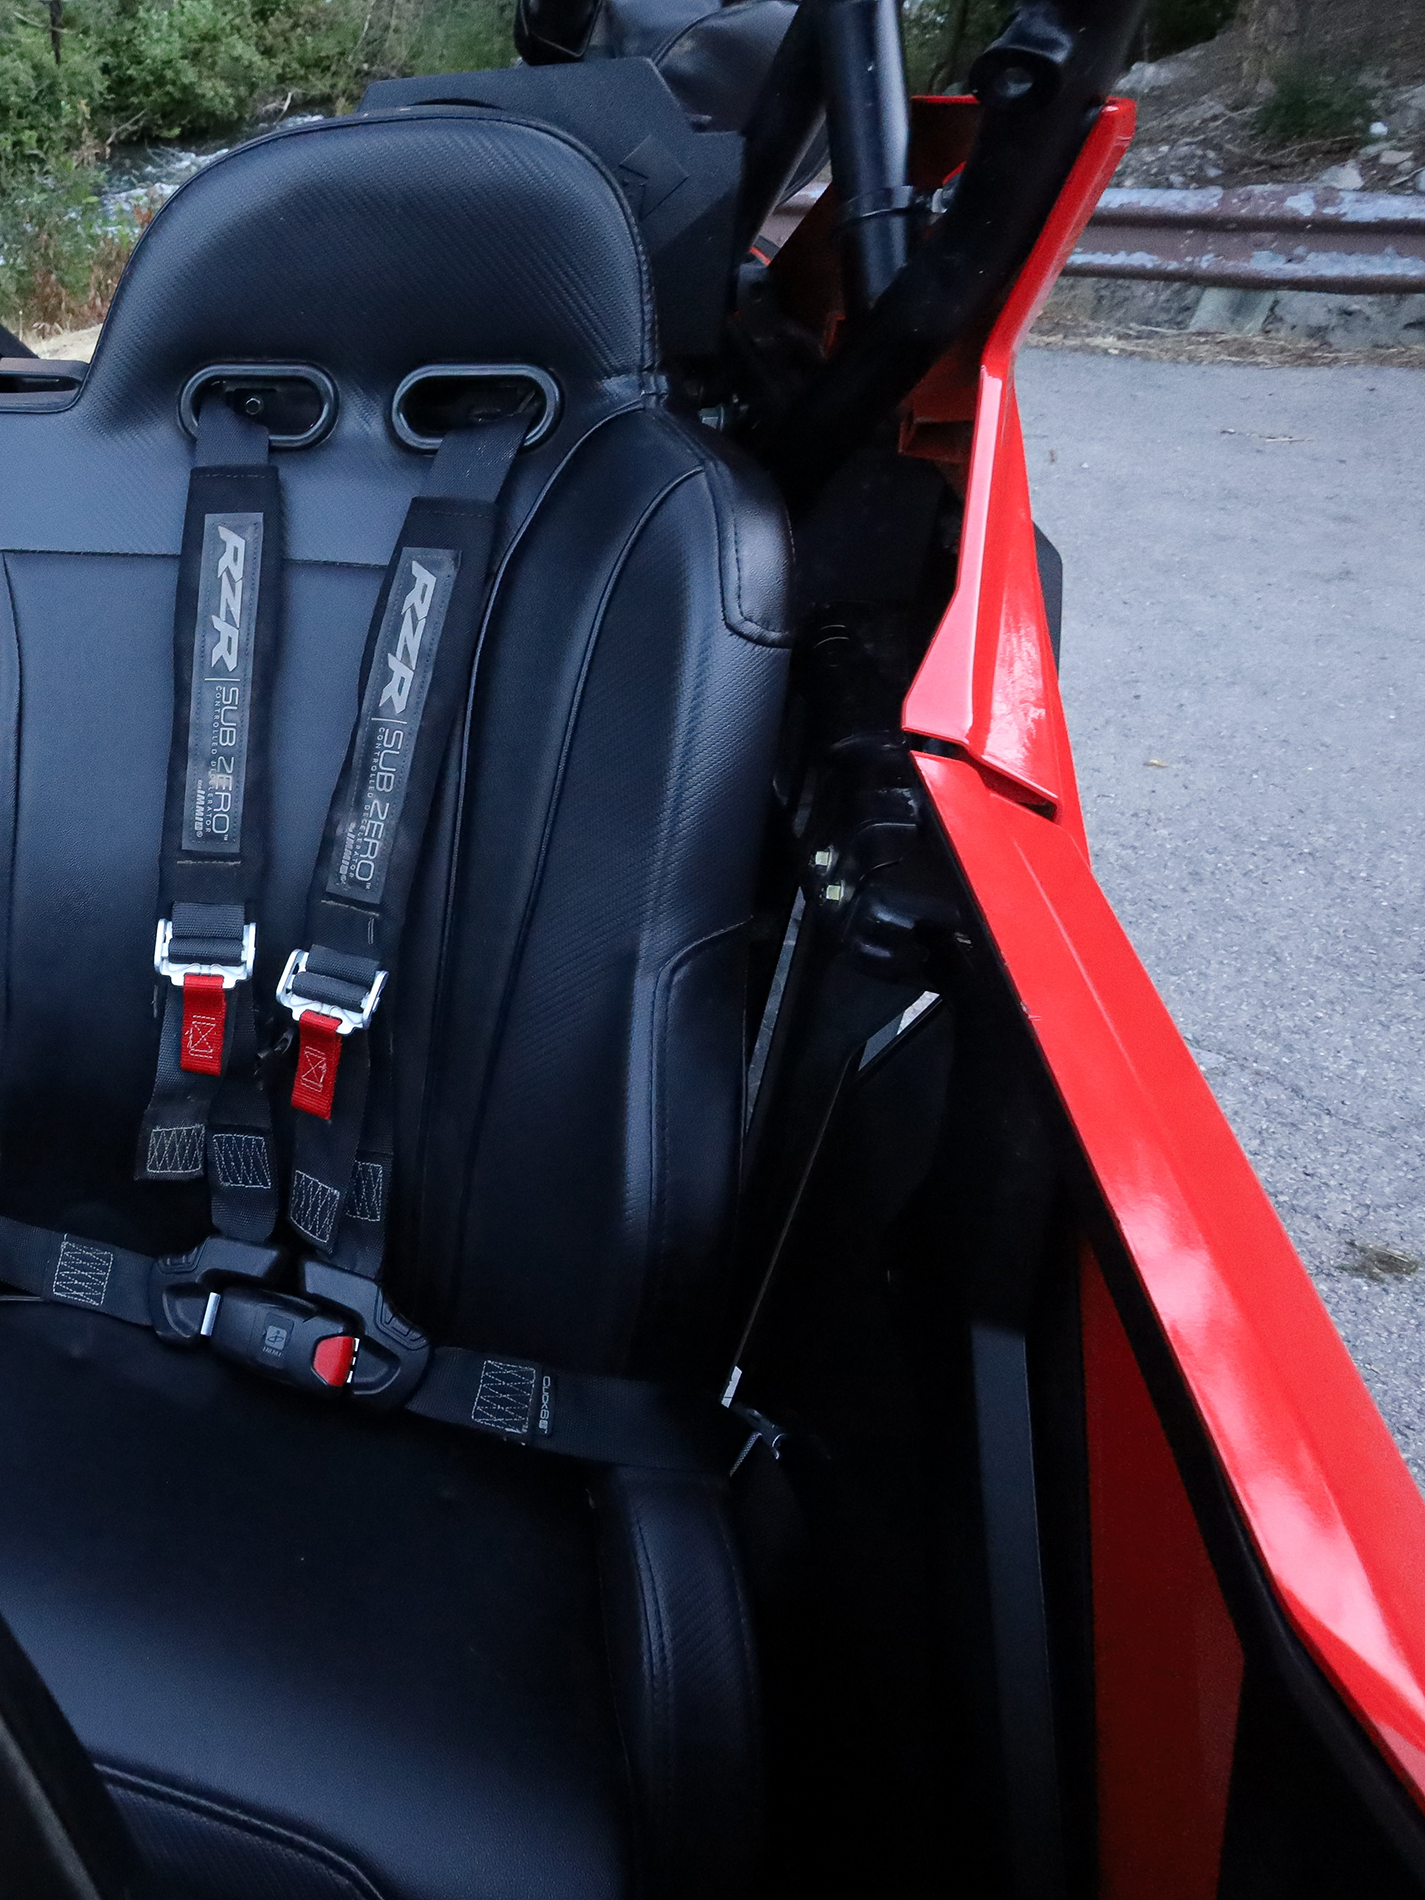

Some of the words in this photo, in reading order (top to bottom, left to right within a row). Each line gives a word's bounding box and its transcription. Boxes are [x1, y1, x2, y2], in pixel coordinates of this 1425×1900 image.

[211, 525, 246, 672] RZR
[379, 560, 436, 714] RZR
[211, 685, 222, 755] CONTROLLED
[219, 687, 239, 747] SUB
[367, 727, 385, 798] CONTROLLED
[376, 729, 404, 793] SUB
